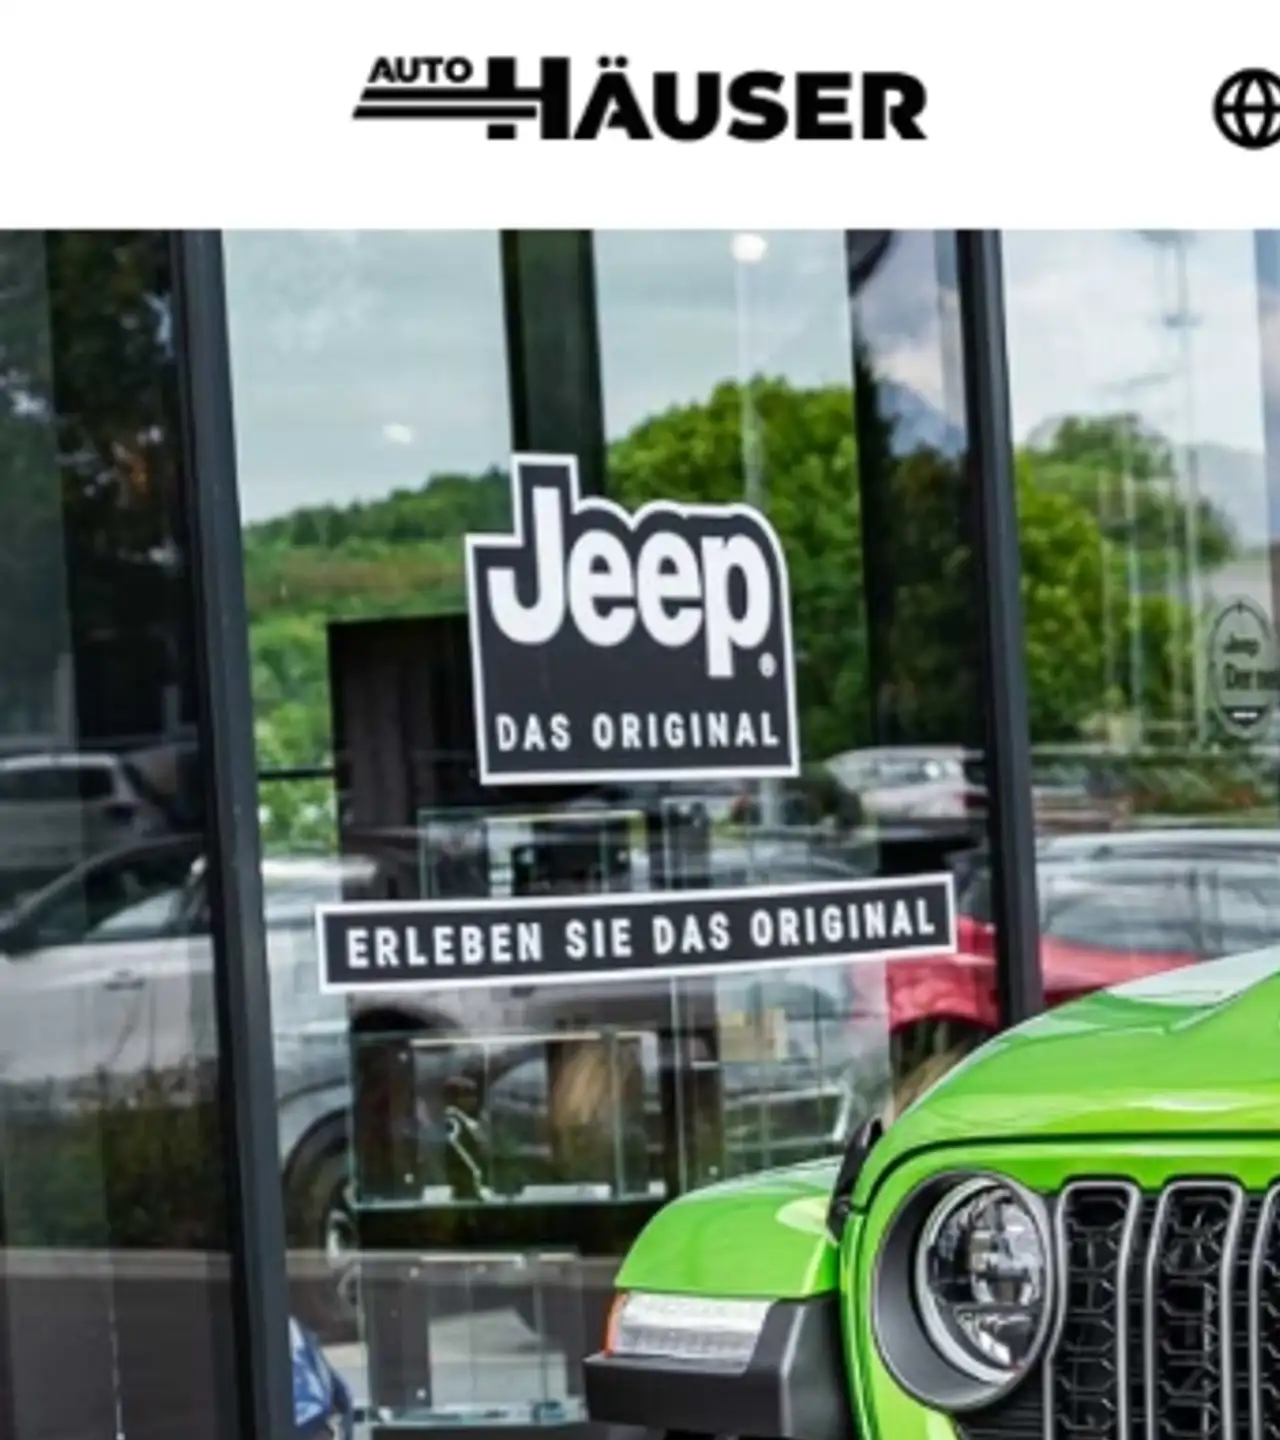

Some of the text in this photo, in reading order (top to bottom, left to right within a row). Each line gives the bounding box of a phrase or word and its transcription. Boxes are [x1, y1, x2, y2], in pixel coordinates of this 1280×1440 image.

[486, 485, 773, 679] Jeep
[495, 710, 780, 752] DAS ORIGINAL
[345, 896, 936, 970] ERLEBEN SIE DAS ORIGINAL
